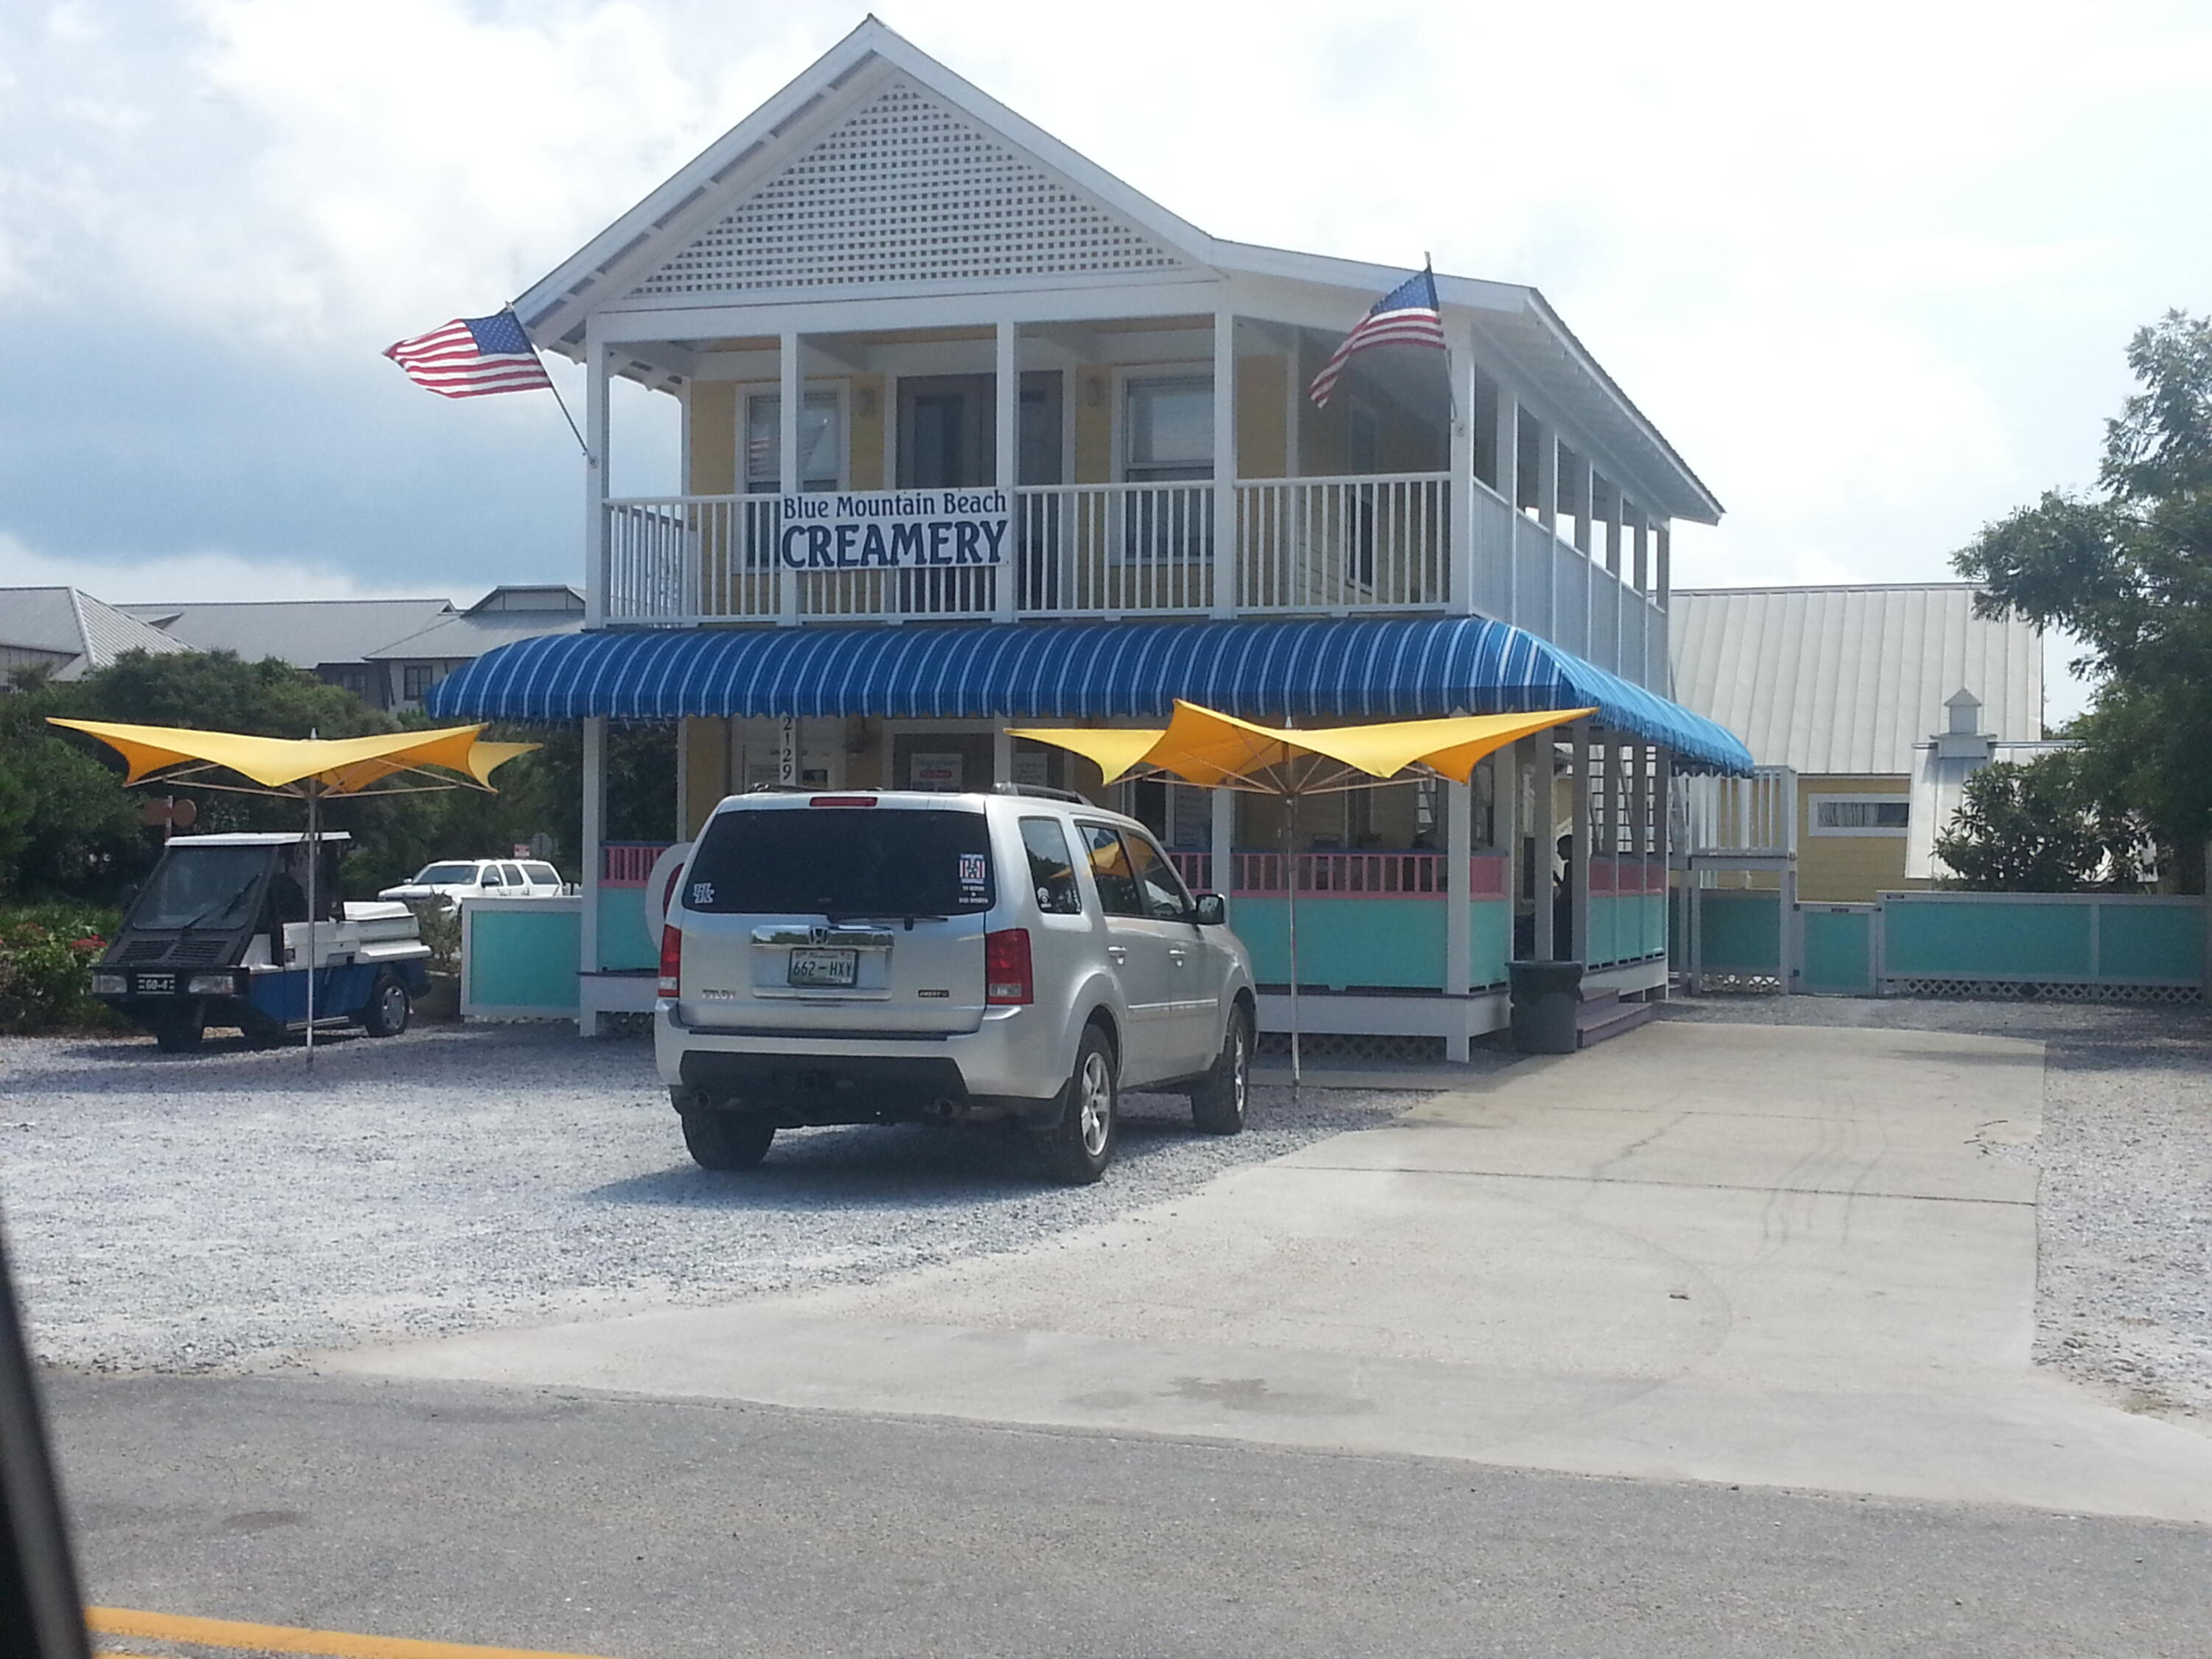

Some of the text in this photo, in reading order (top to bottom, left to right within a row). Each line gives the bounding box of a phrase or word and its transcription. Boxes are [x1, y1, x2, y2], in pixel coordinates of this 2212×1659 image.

[783, 490, 1007, 518] Blue Mountain Beach
[782, 520, 1008, 568] CREAMERY
[783, 717, 793, 780] 2129
